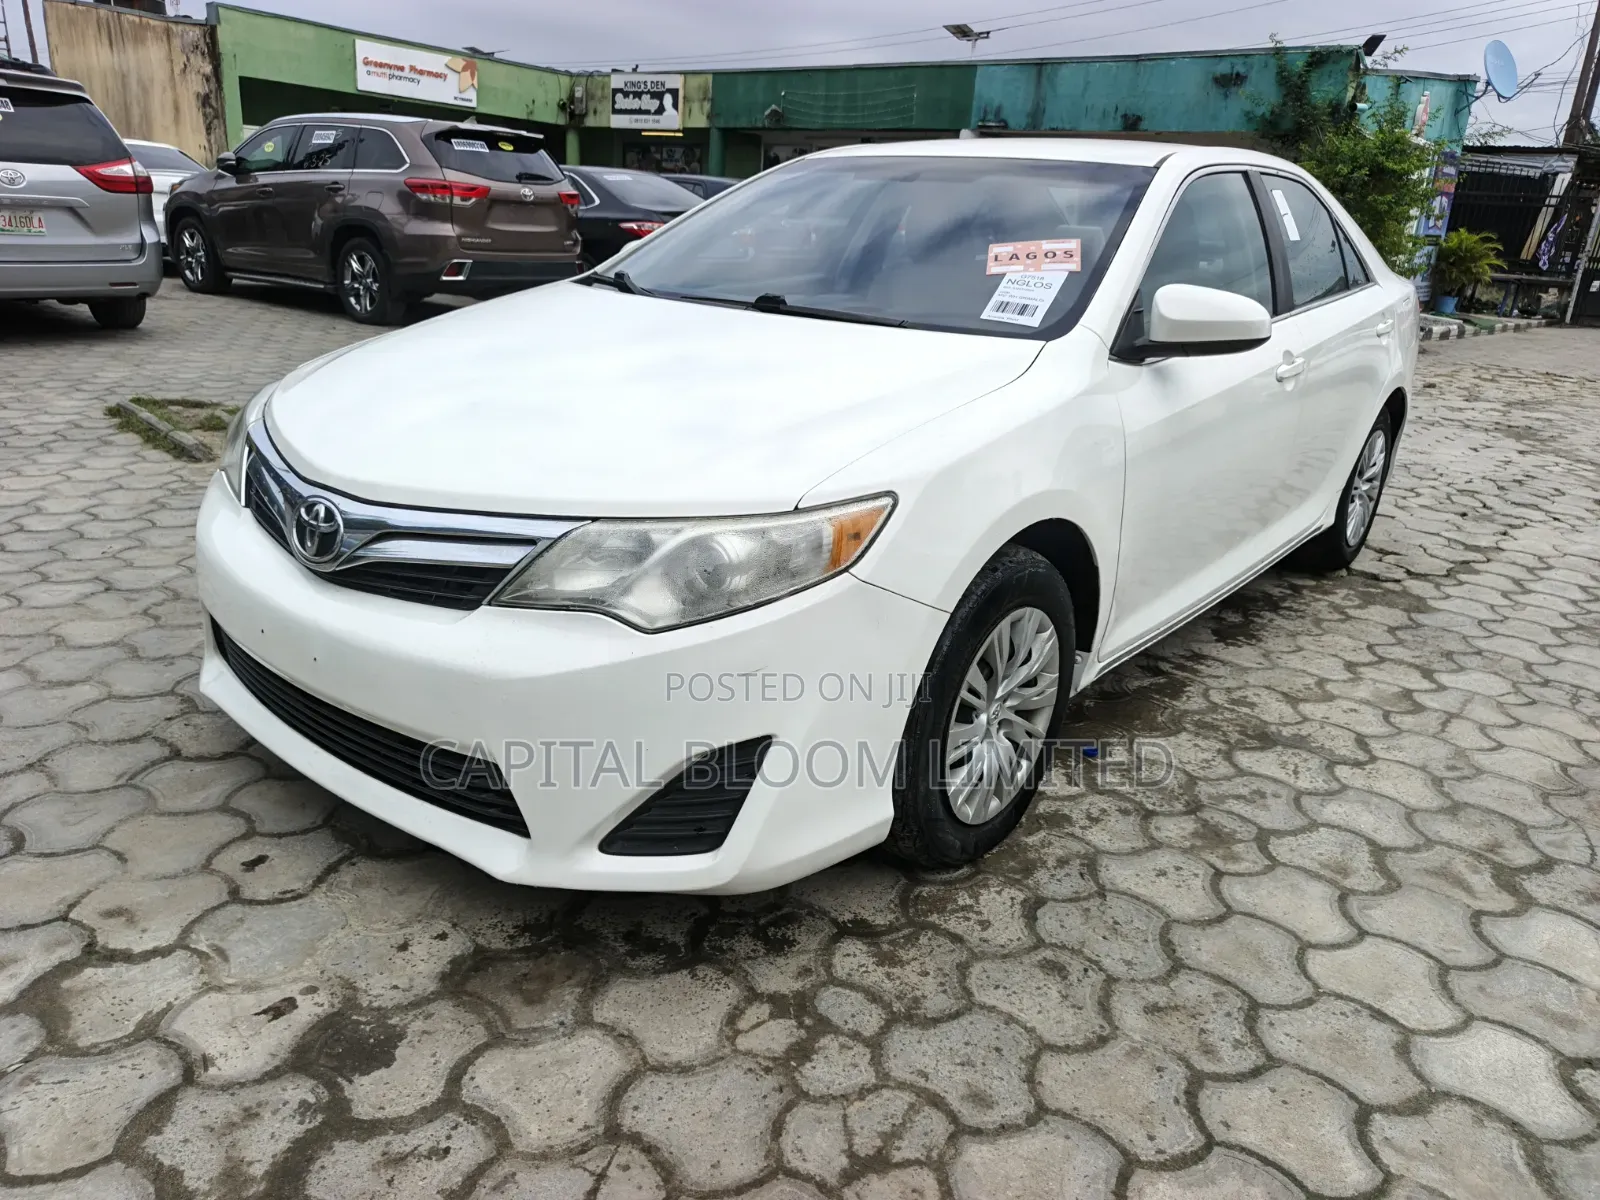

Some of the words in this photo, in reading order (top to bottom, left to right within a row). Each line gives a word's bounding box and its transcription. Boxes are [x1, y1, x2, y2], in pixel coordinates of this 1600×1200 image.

[388, 72, 421, 86] pharmacy
[409, 64, 448, 82] Pharmacy
[623, 80, 649, 90] KING'S
[650, 80, 666, 90] DEN
[994, 250, 1074, 262] LAGOS
[1006, 278, 1053, 289] NGLOS
